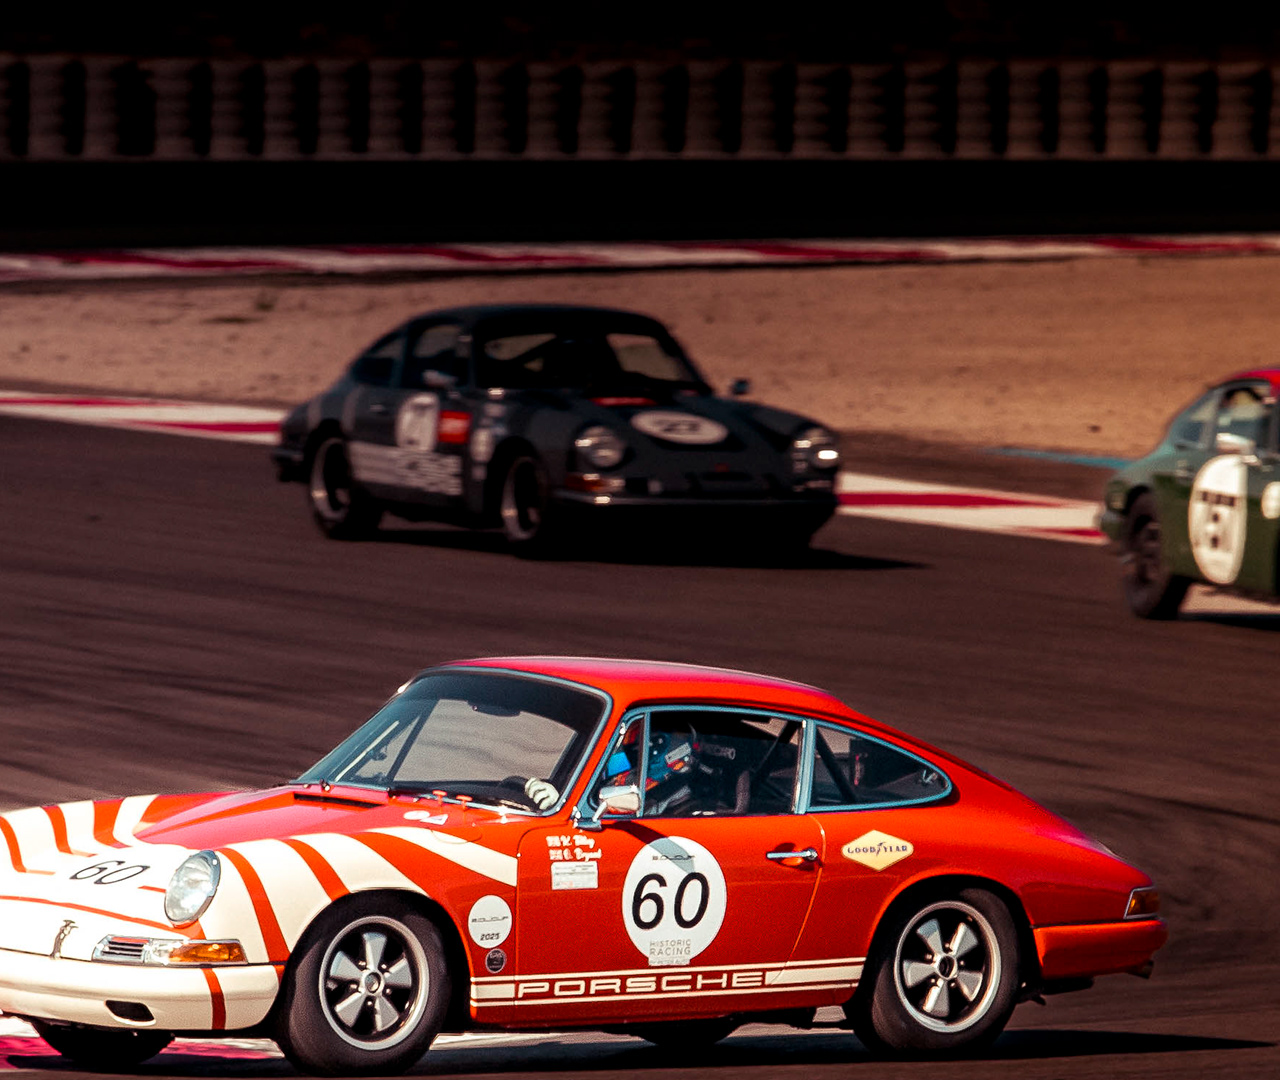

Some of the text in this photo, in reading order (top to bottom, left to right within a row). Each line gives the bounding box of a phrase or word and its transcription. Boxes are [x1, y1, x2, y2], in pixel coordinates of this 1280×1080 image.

[69, 860, 150, 885] 60
[632, 872, 710, 930] 60
[480, 932, 500, 941] 2025
[649, 939, 691, 947] HISTORIC
[649, 946, 691, 956] RACING
[518, 971, 764, 999] PORSCHE
